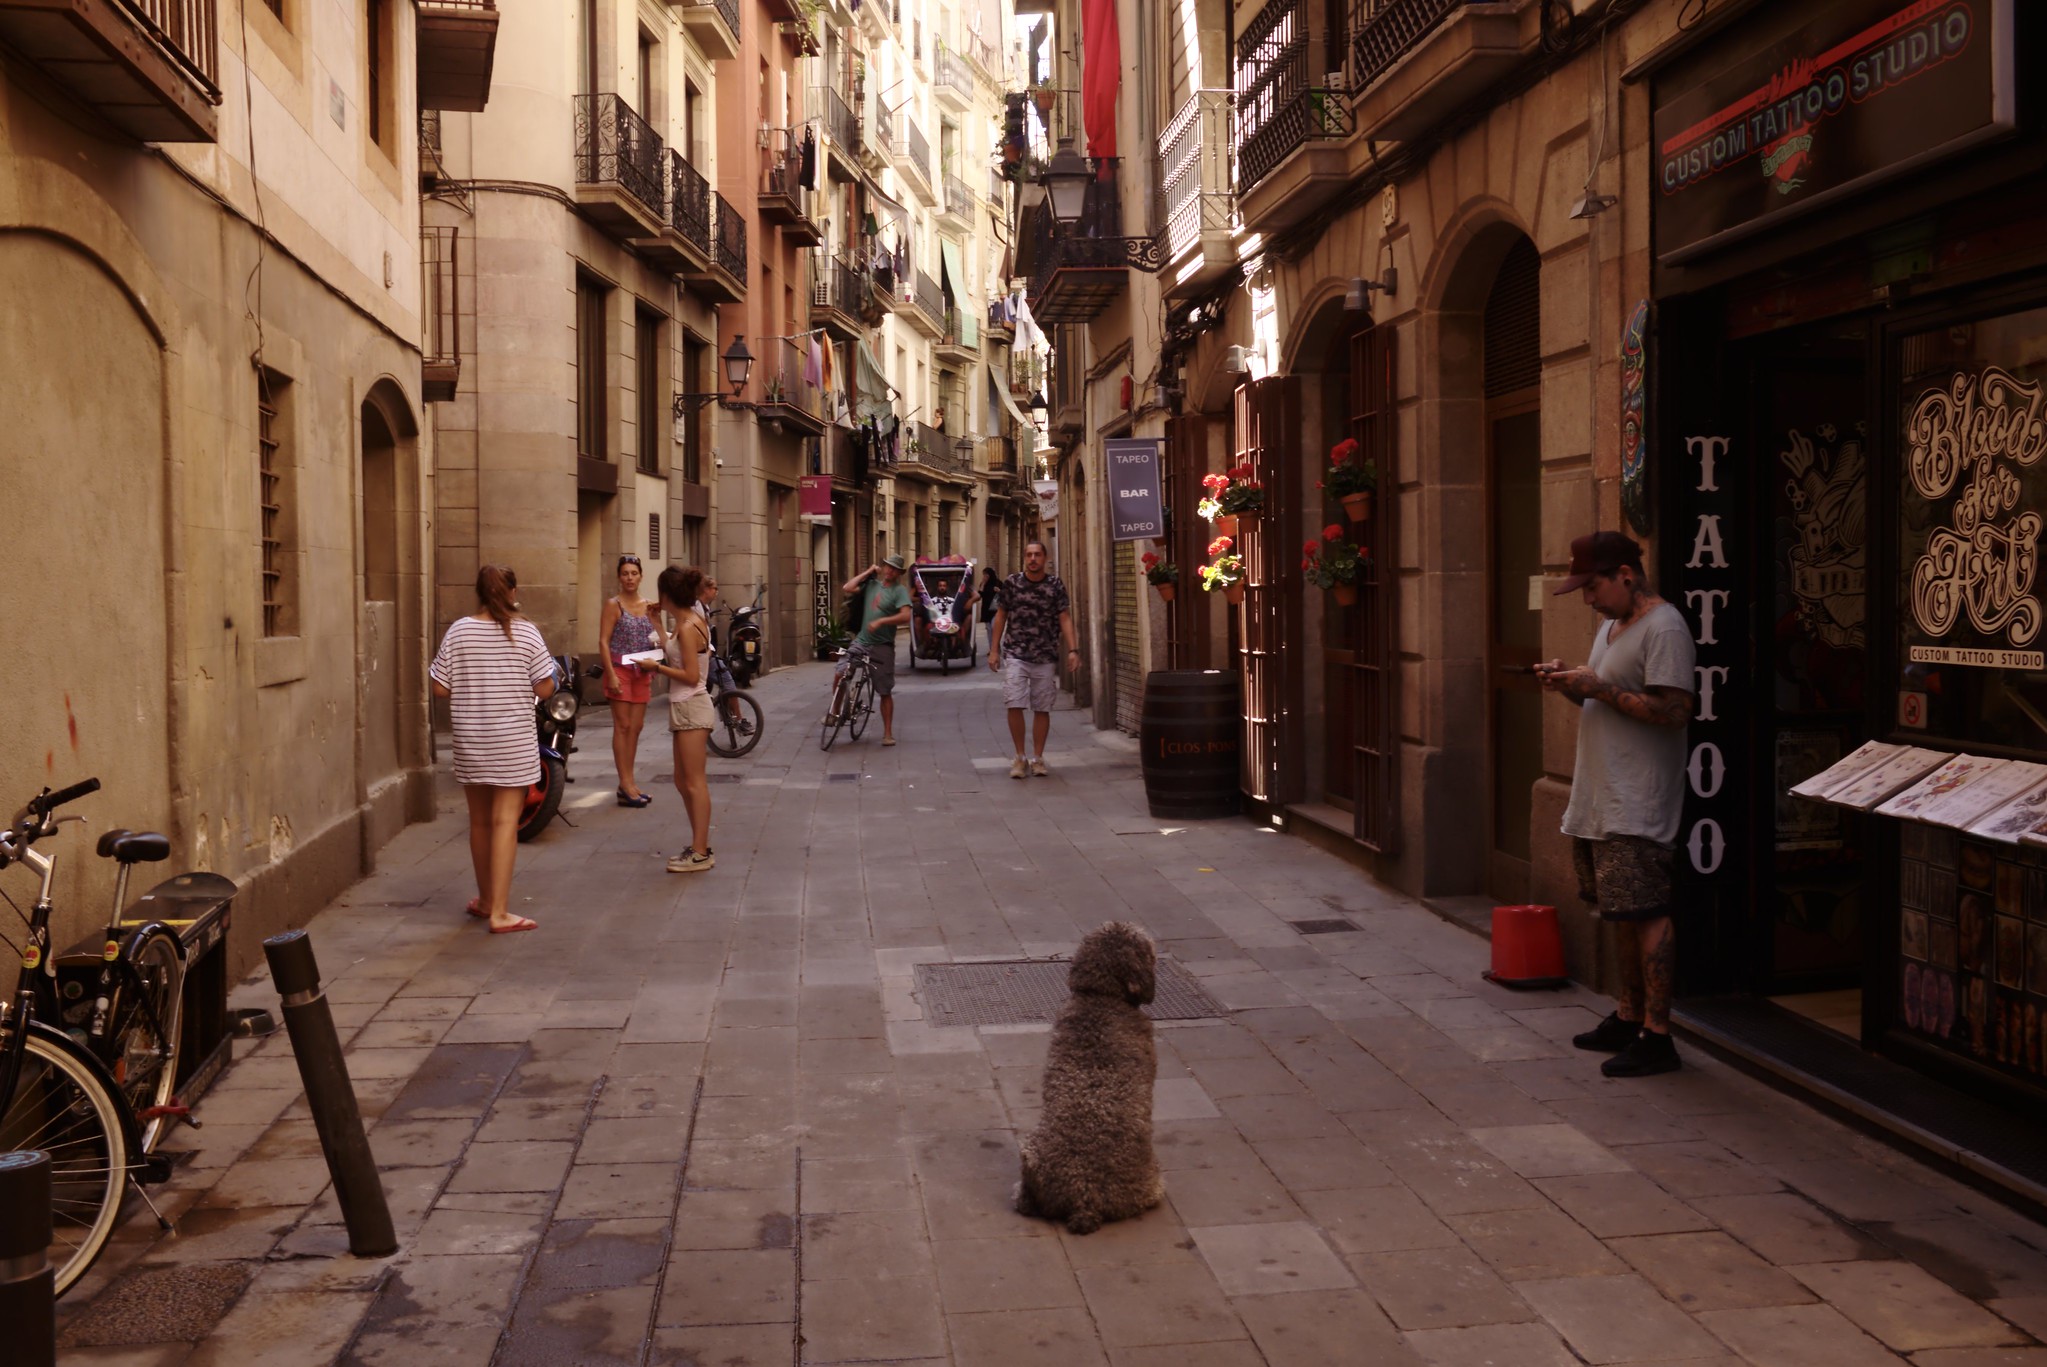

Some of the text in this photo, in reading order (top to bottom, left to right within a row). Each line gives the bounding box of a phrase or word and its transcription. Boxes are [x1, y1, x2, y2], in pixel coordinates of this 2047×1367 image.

[1664, 125, 1747, 187] CUSTOM
[1752, 73, 1845, 147] TATTOO
[1852, 10, 1969, 97] STUDIO
[1115, 455, 1149, 464] TAPEO
[1909, 366, 2047, 499] Blood
[1120, 489, 1149, 498] BAR
[1120, 522, 1154, 532] TAPEO
[1953, 453, 2021, 536] for
[1911, 513, 2043, 648] Art
[1683, 435, 1731, 875] TATTOO
[1911, 648, 2042, 668] CUSTOM TATTOO STUDIO
